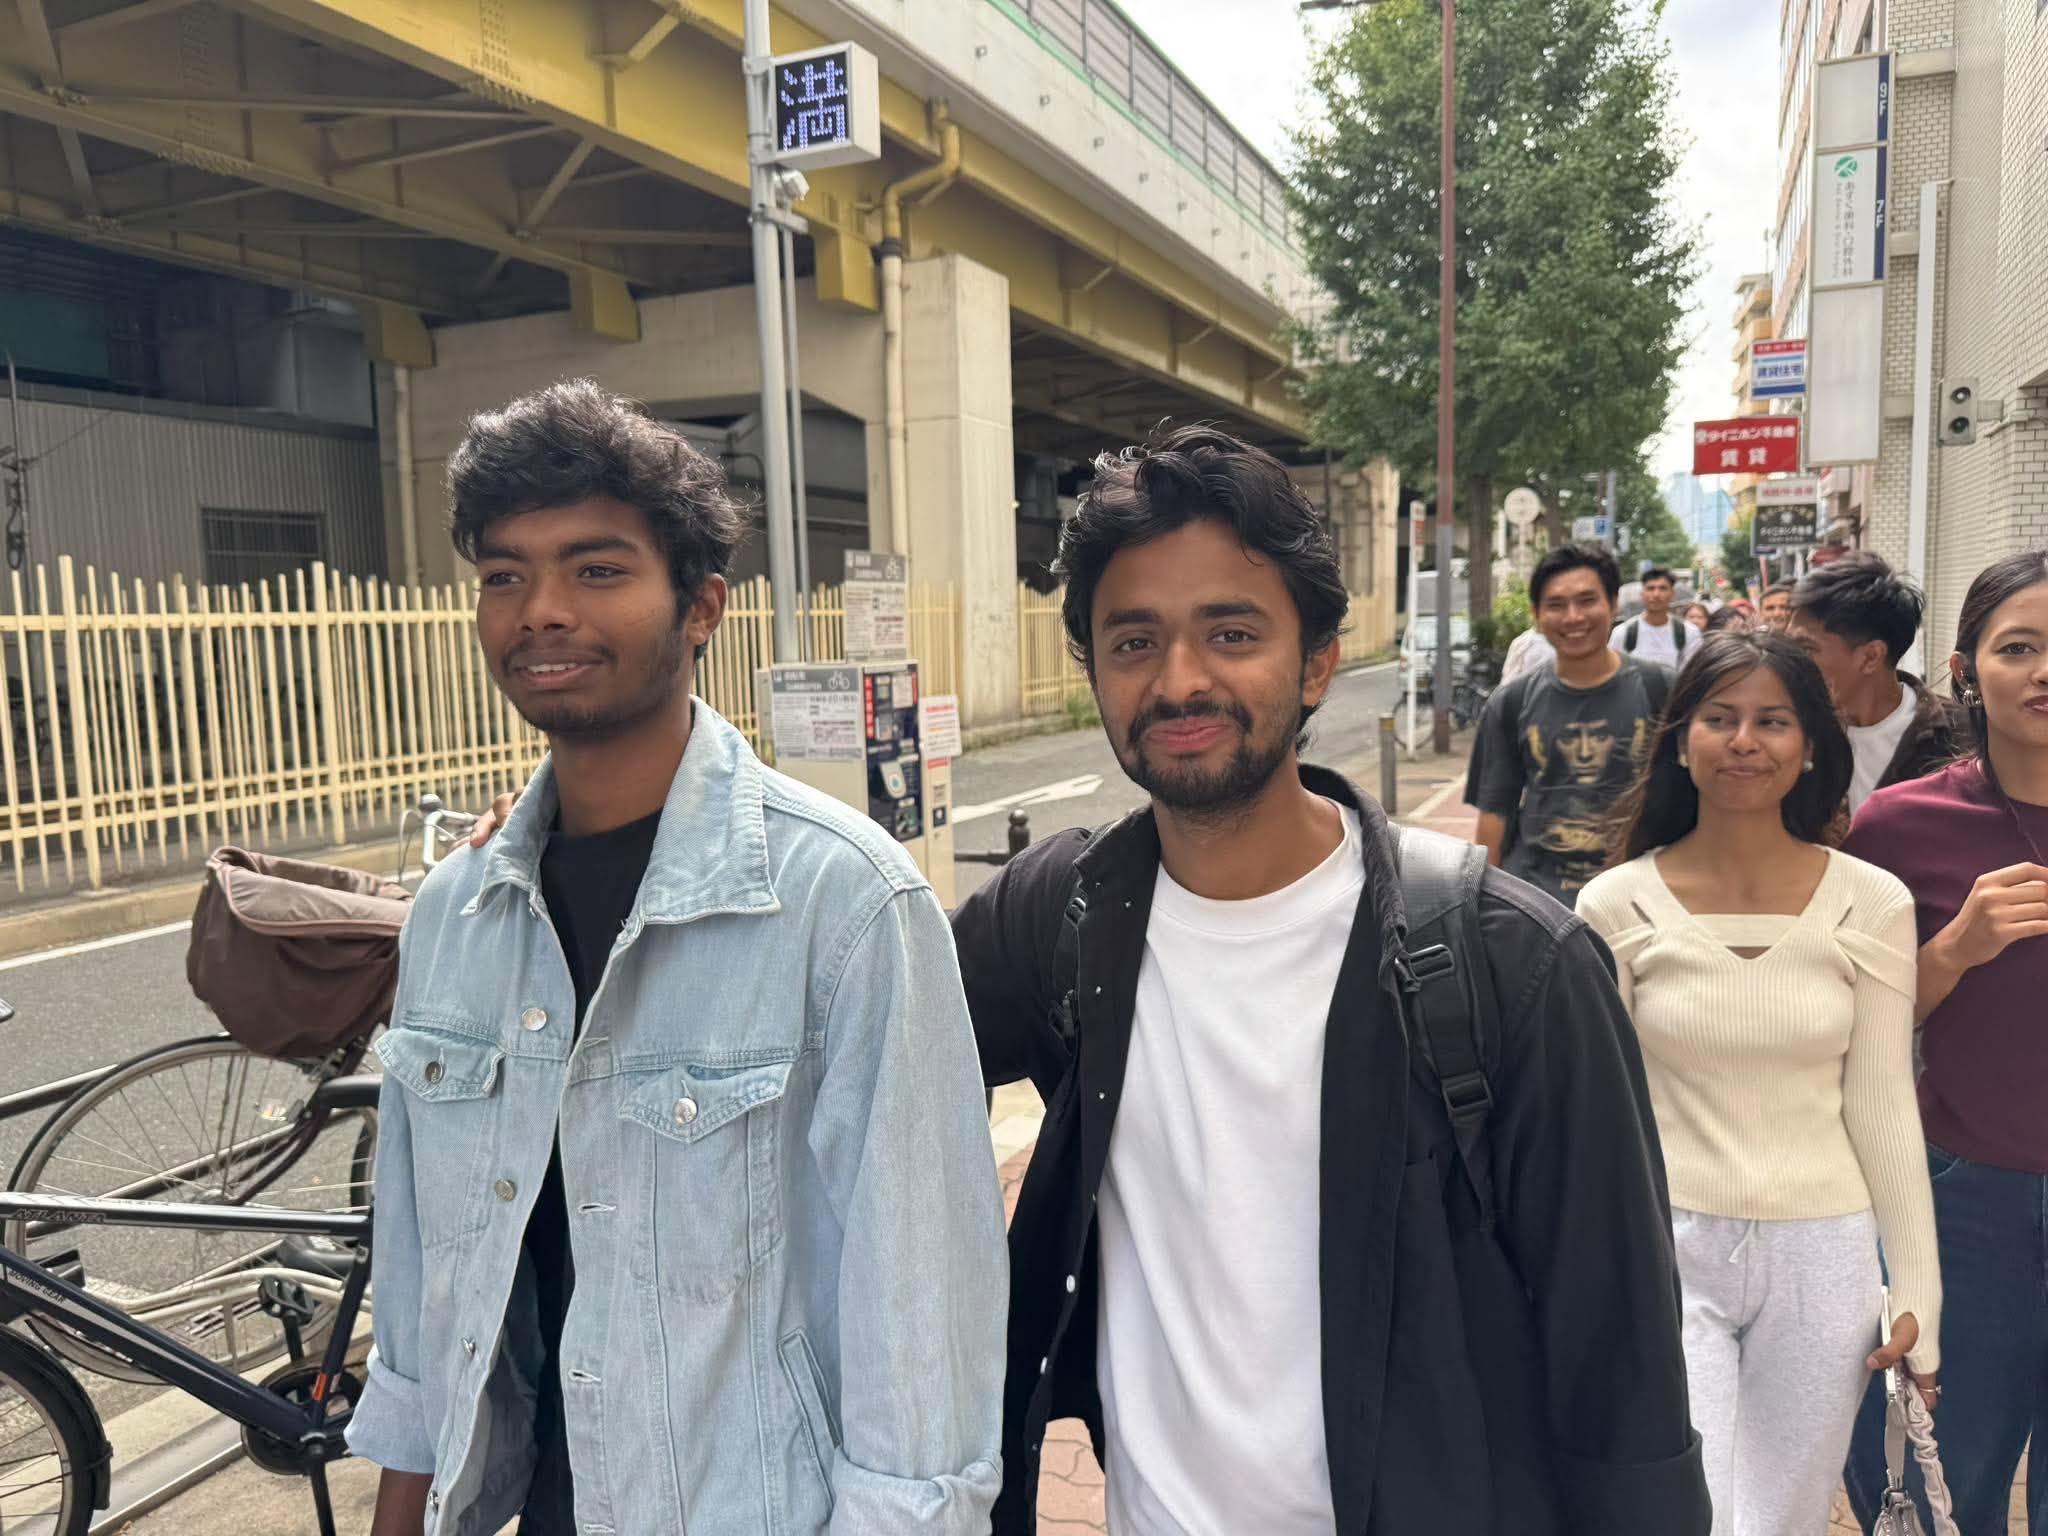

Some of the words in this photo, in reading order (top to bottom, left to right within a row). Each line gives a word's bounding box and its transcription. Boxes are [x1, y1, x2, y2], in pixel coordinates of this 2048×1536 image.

[780, 59, 849, 152] 満
[1879, 82, 1888, 116] 9F
[1875, 199, 1885, 229] 7F
